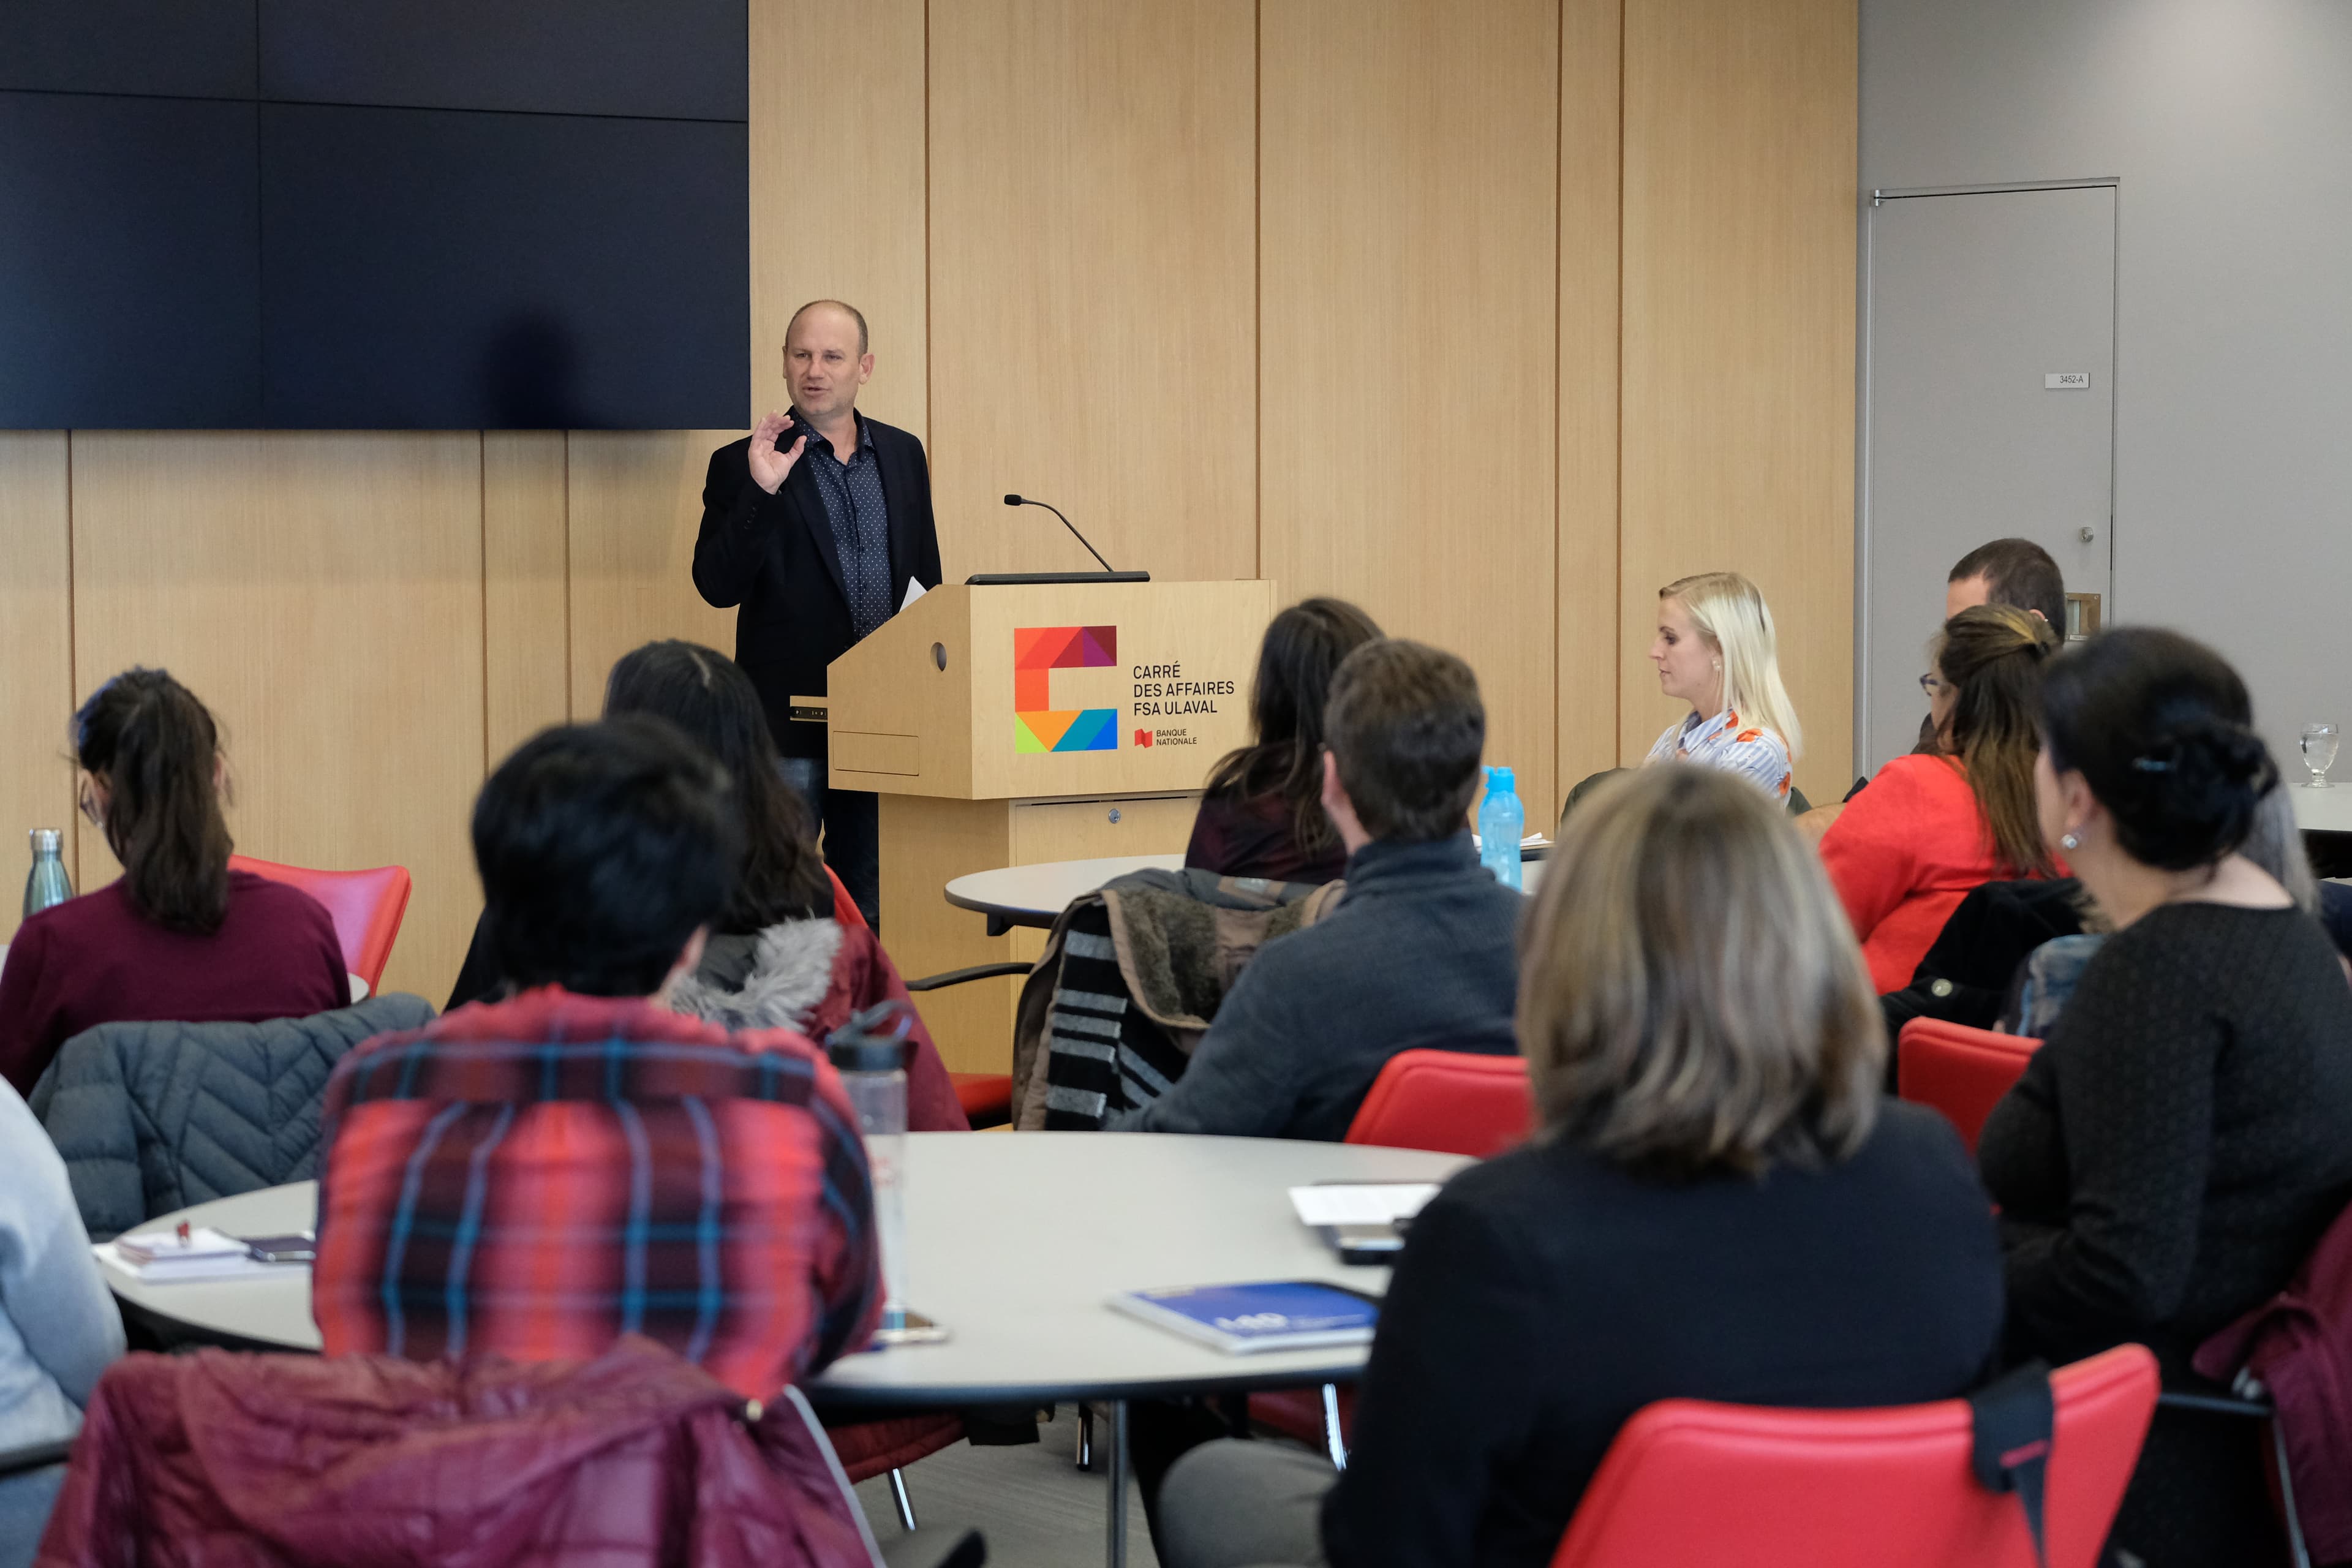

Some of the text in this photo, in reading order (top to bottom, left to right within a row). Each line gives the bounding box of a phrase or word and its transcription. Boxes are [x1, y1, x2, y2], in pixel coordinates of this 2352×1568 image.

[2059, 375, 2084, 383] 3452-A
[1133, 660, 1181, 679] CARRÉ
[1134, 680, 1235, 698] DES AFFAIRES
[1134, 700, 1218, 716] FSA ULAVAL
[1156, 728, 1187, 737] BANQUE
[1156, 737, 1197, 745] NATIONALE
